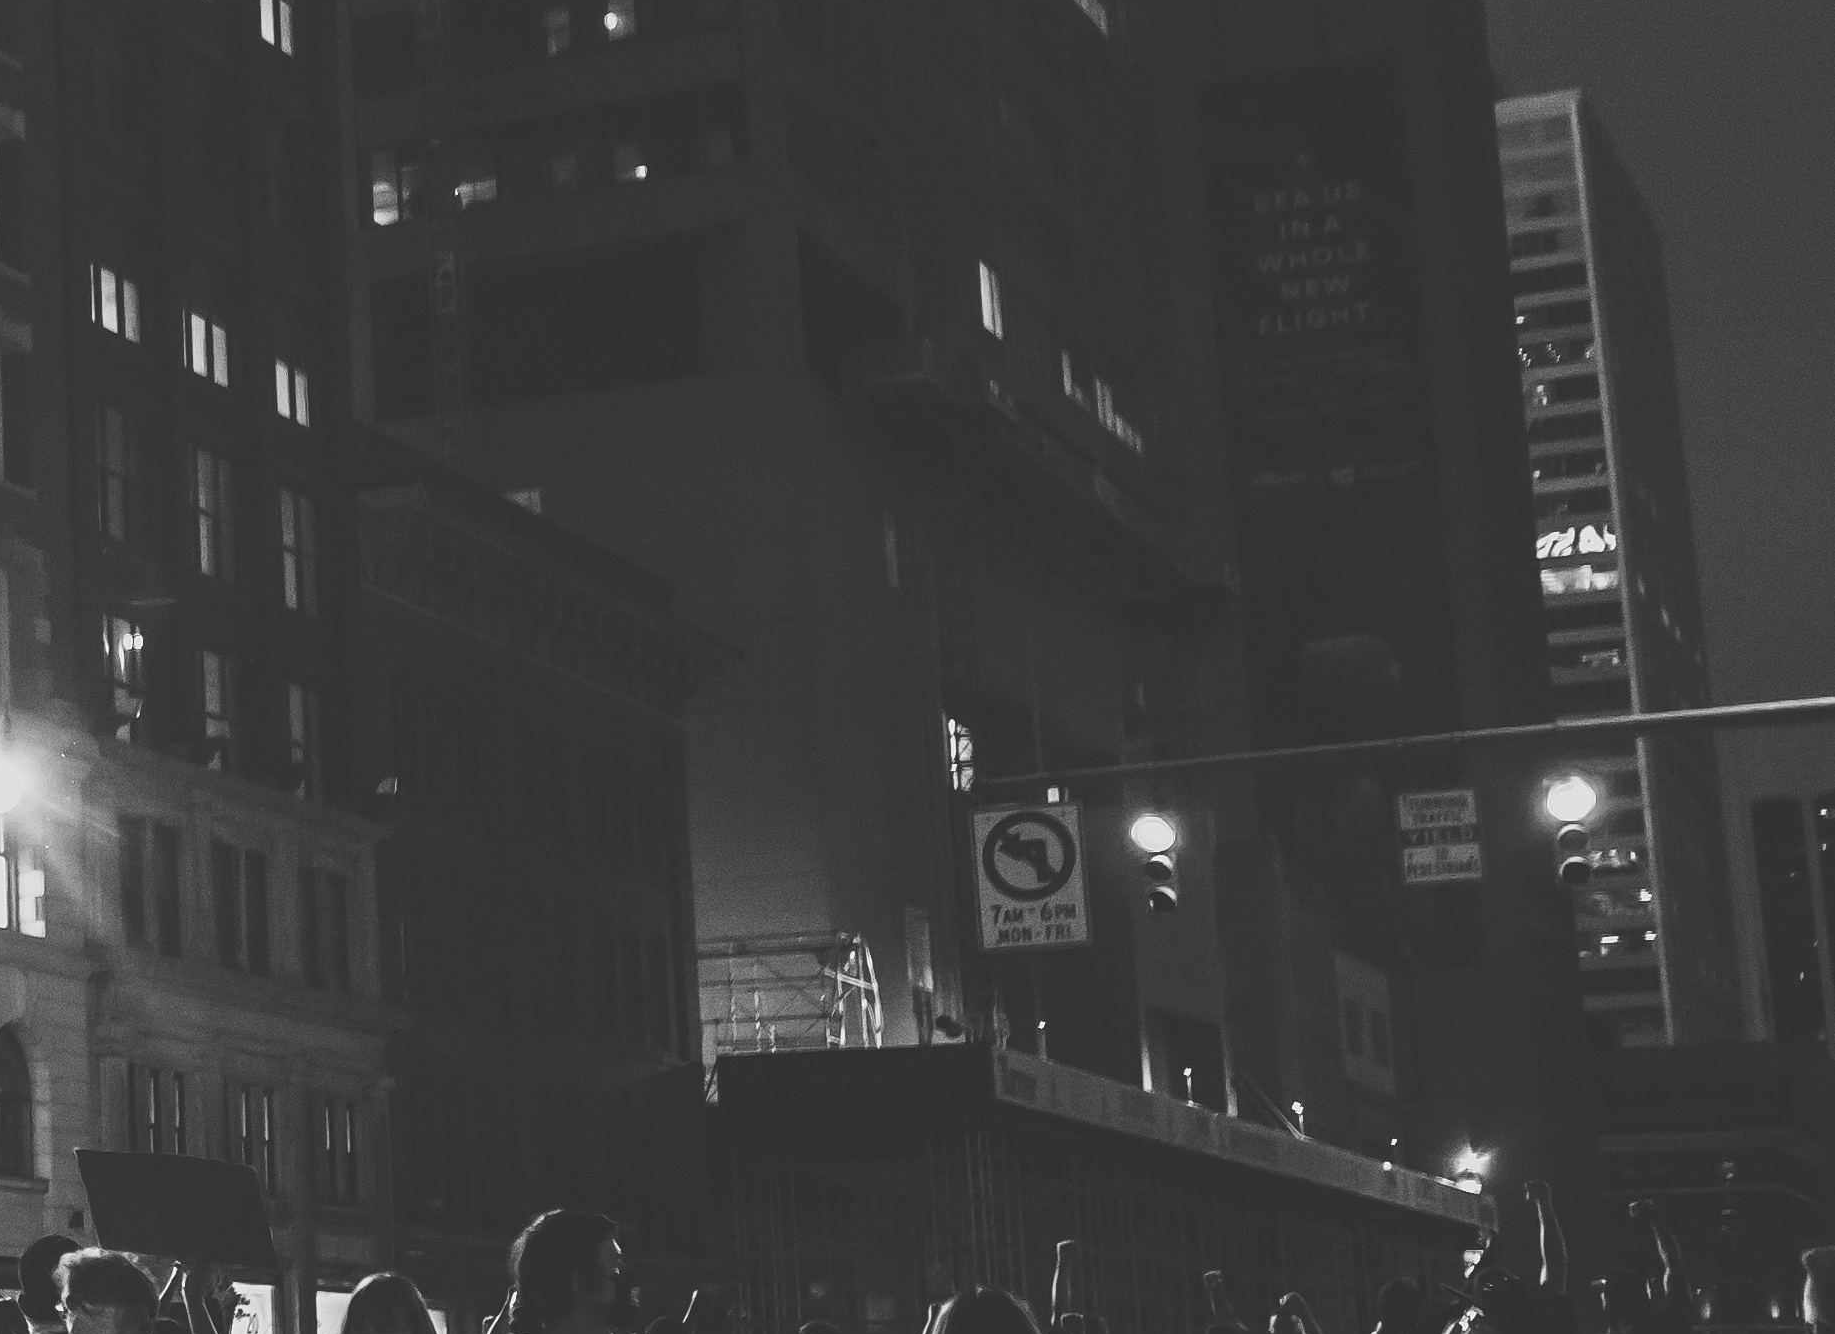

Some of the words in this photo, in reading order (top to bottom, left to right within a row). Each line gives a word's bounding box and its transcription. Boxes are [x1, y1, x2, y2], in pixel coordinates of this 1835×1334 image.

[1278, 218, 1313, 242] IN
[1321, 214, 1343, 235] A
[1255, 237, 1371, 276] WHOLE
[1278, 273, 1352, 302] NEW
